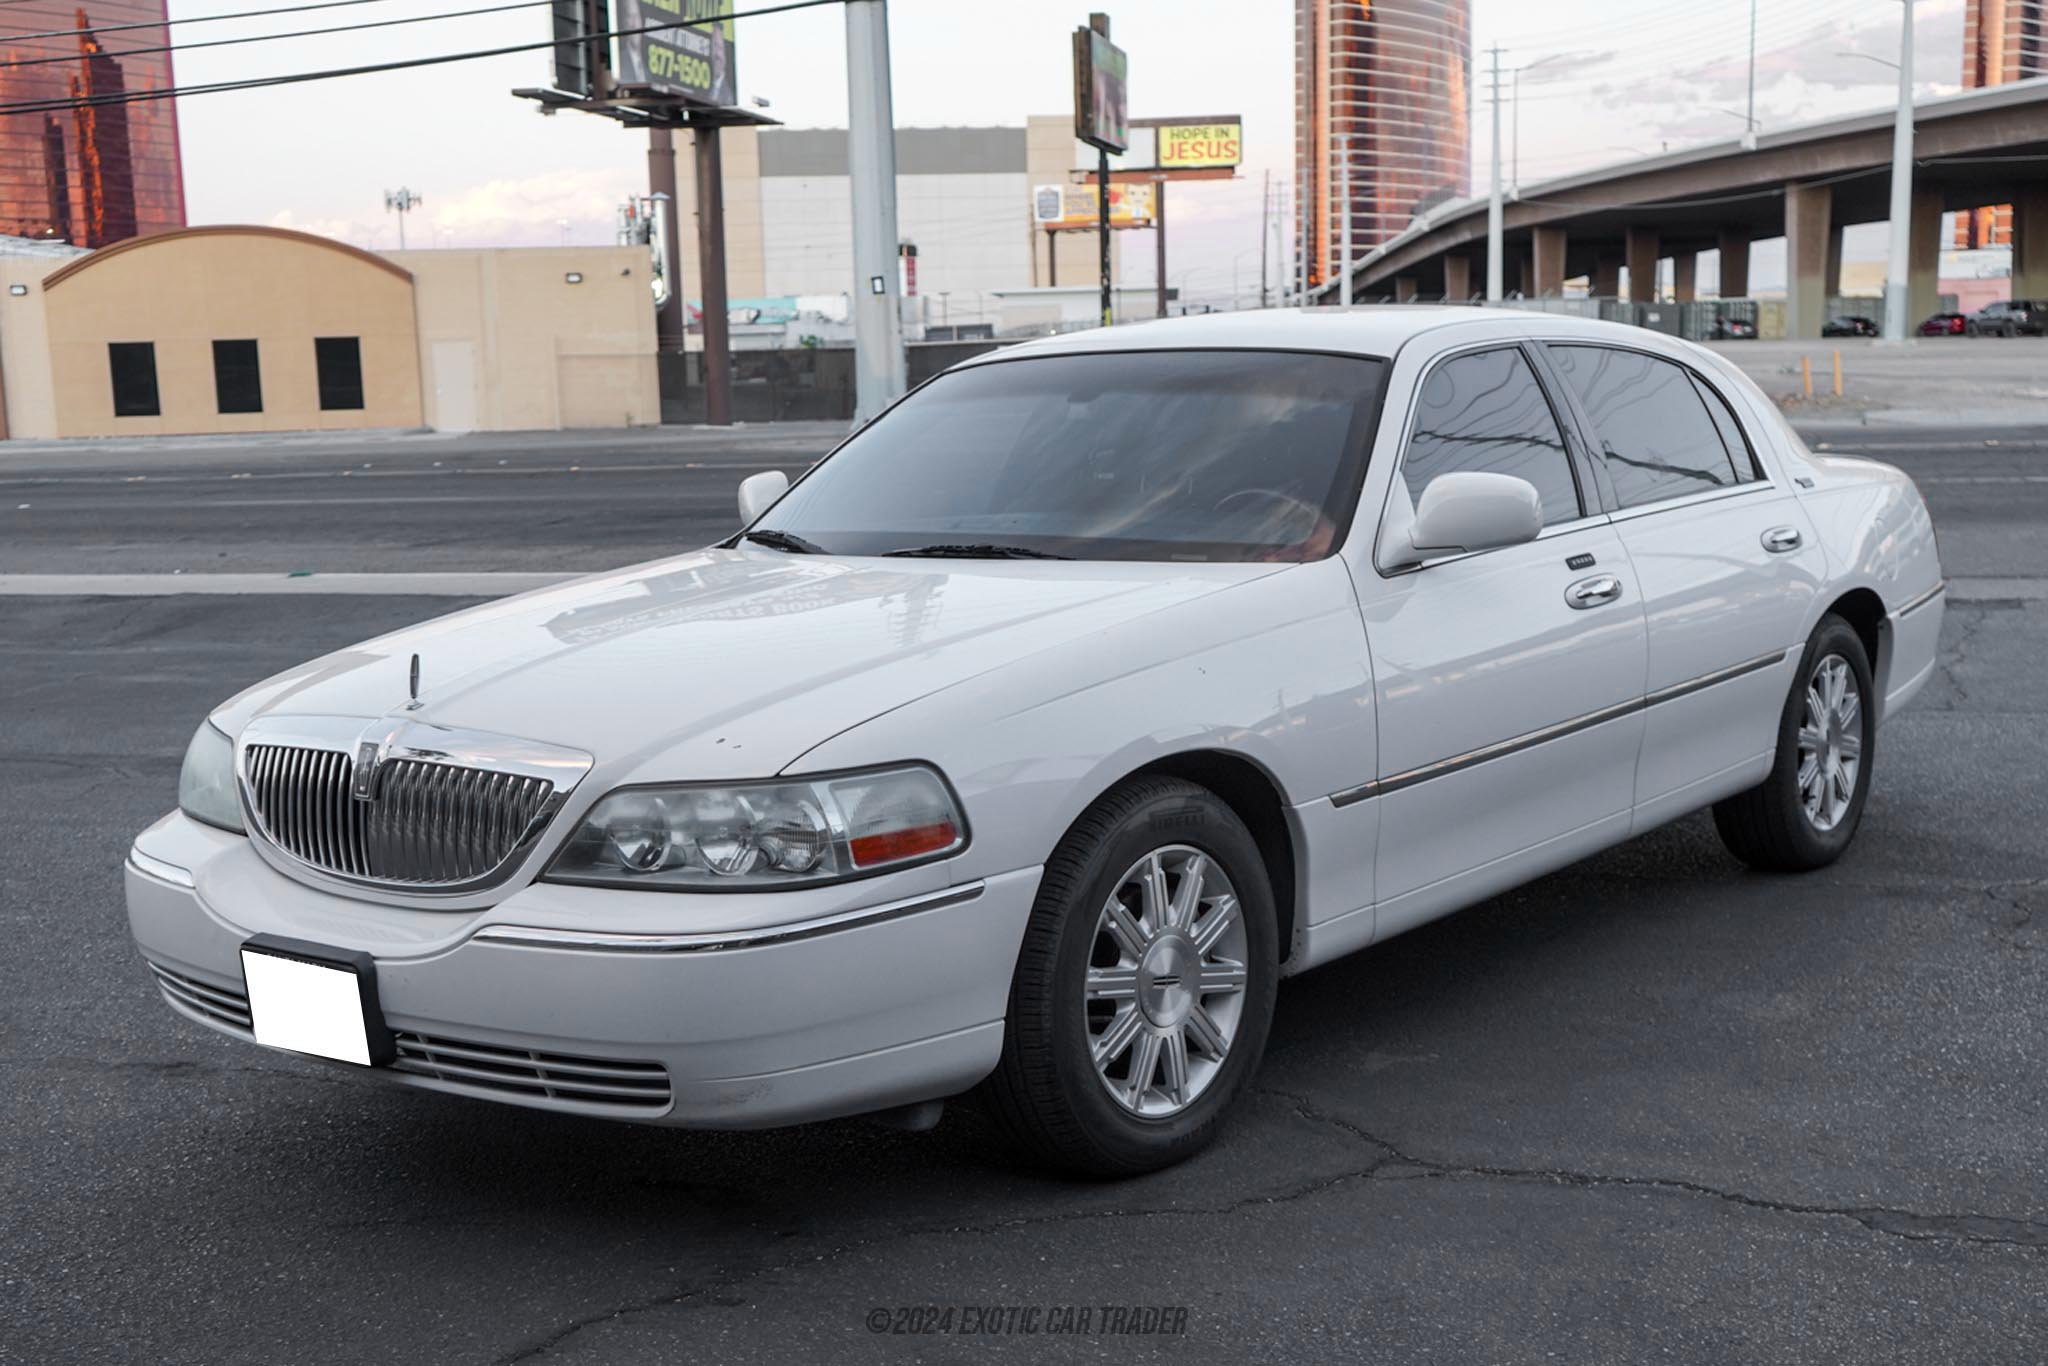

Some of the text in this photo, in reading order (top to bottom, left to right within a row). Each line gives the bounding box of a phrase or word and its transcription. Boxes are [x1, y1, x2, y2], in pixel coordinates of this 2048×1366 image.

[648, 44, 711, 90] 877-1500
[1170, 126, 1230, 140] HOPE IN
[1163, 140, 1238, 161] JESUS
